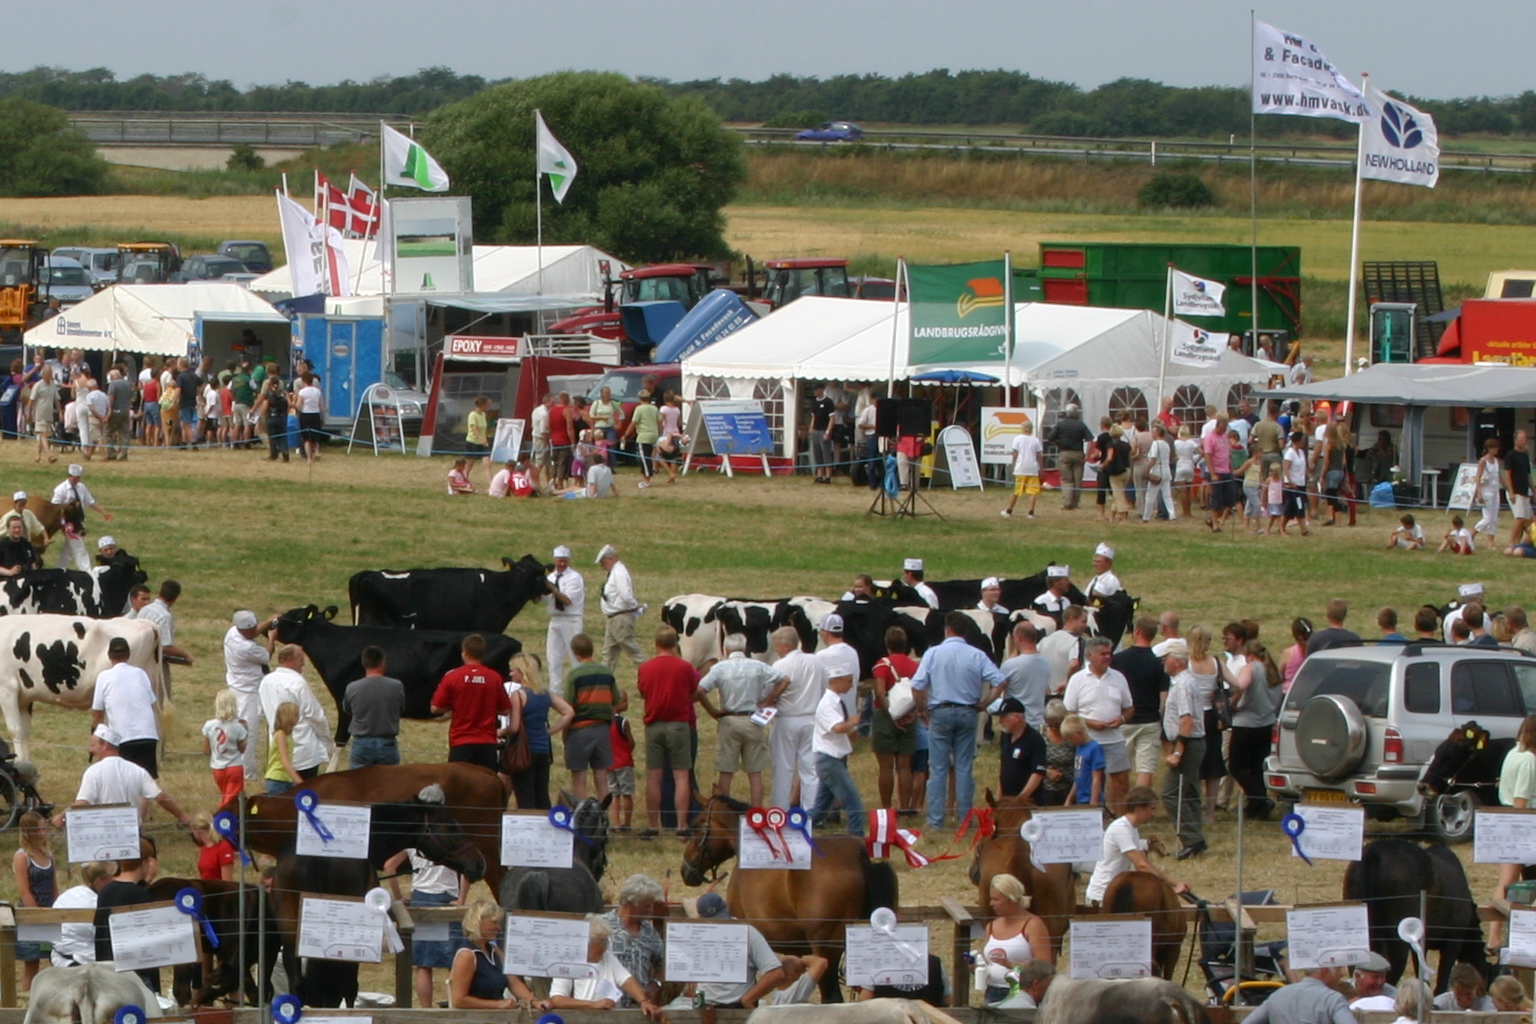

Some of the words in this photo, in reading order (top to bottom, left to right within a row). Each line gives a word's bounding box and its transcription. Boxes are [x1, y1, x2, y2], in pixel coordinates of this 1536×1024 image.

[1264, 47, 1275, 61] &
[452, 339, 483, 353] EPOXY
[513, 478, 527, 490] 10
[902, 975, 914, 983] 173
